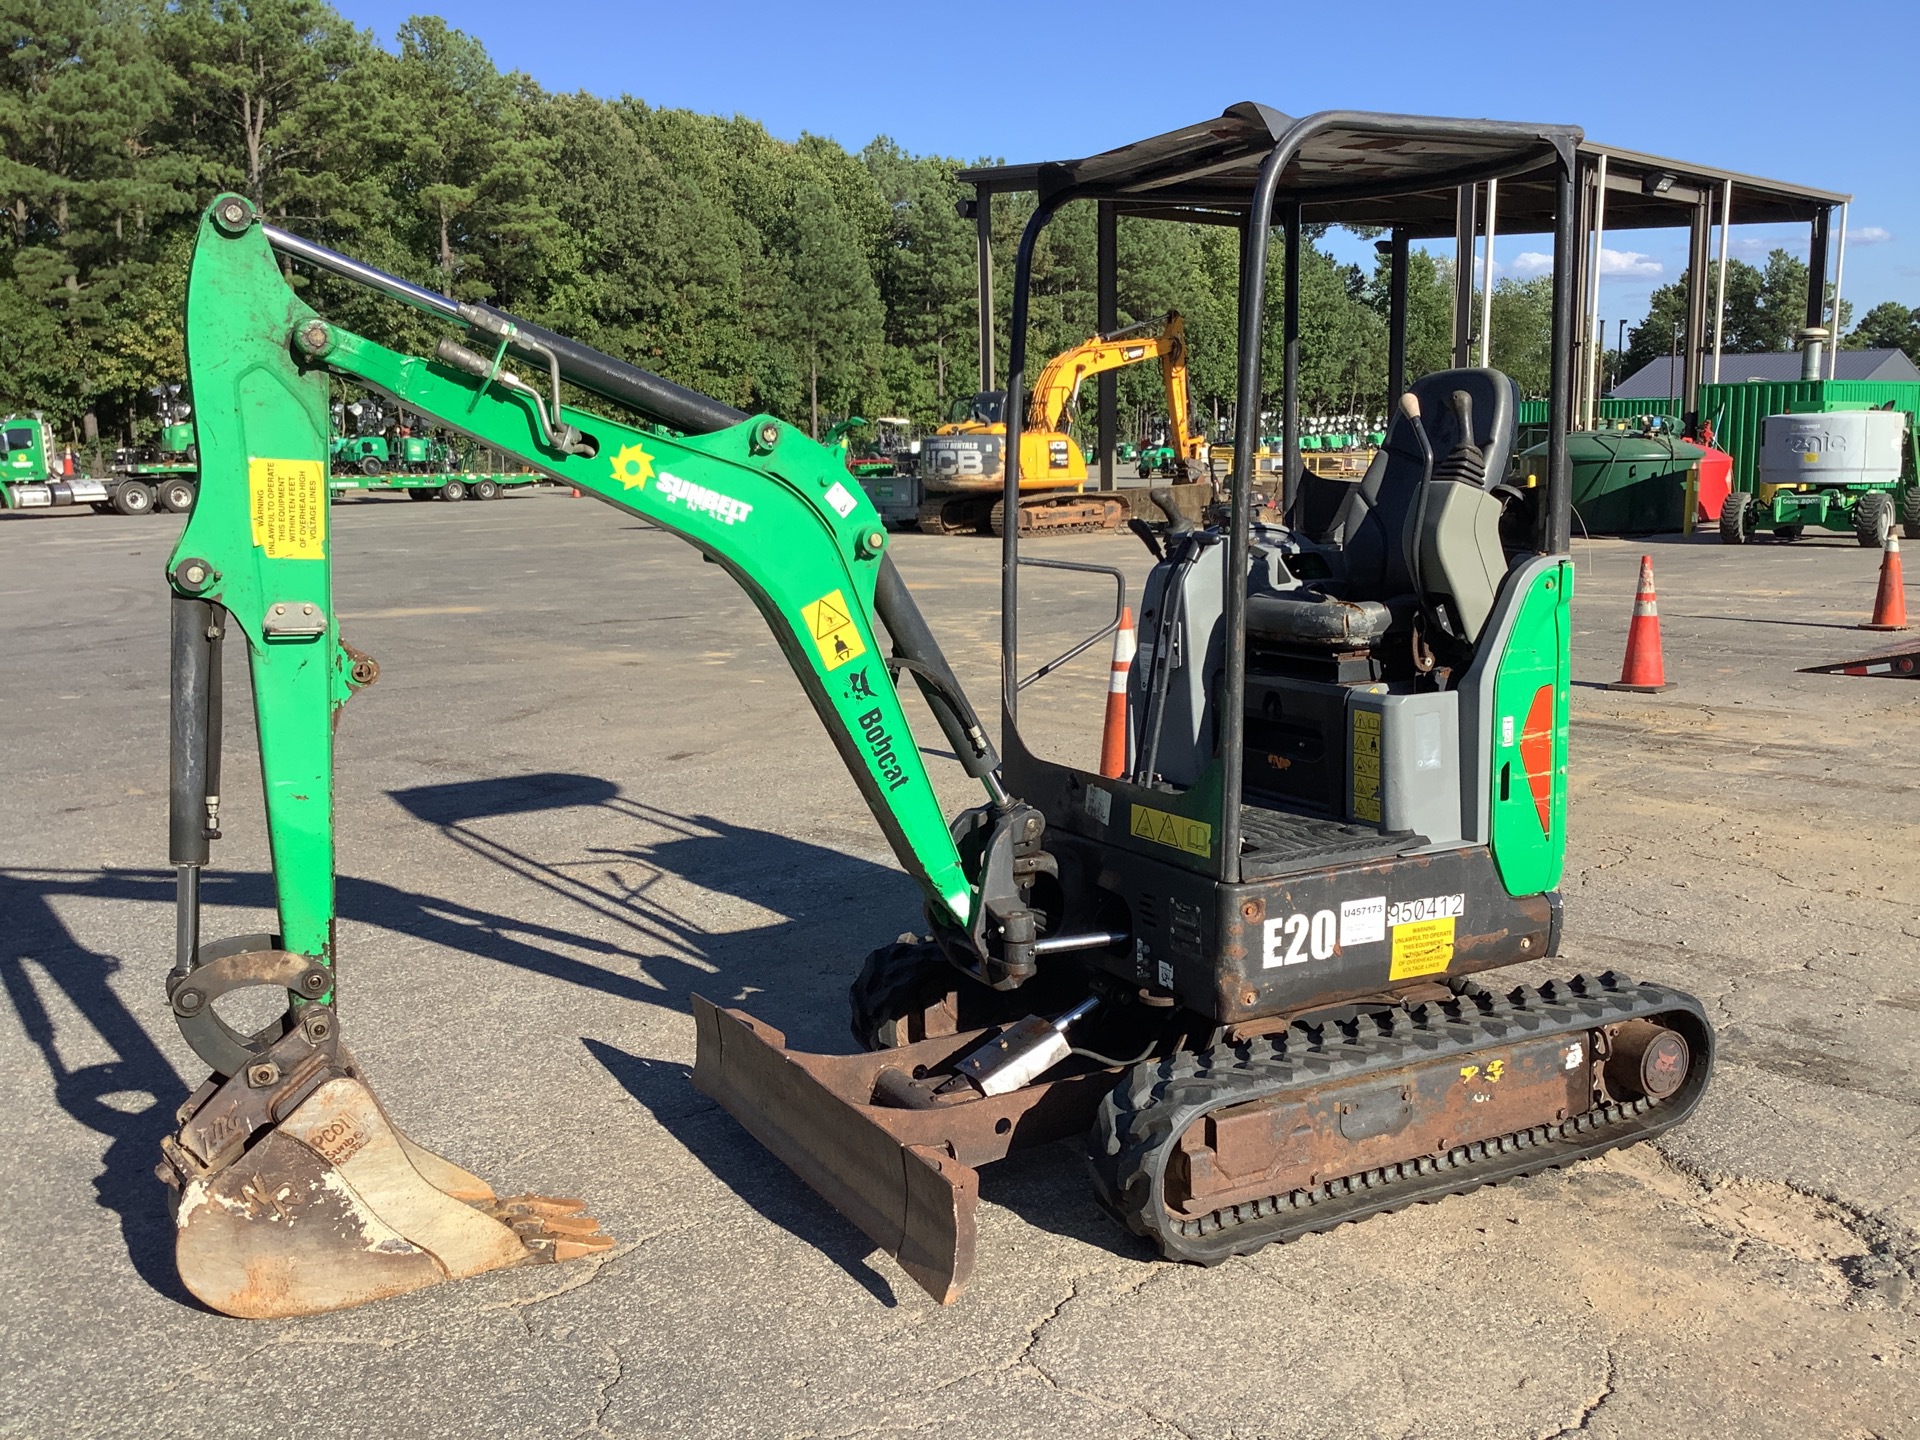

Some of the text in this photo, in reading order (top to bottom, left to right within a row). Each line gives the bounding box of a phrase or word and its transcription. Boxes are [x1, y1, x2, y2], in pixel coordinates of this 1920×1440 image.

[950, 442, 979, 450] RENTALS
[925, 450, 984, 475] JCB
[655, 471, 753, 523] SUNBELT
[257, 490, 265, 527] WARNING
[268, 501, 275, 512] TO
[278, 525, 286, 542] THIS
[300, 537, 306, 548] OF
[858, 706, 910, 792] Bobcat
[1343, 904, 1383, 917] U457173
[1388, 894, 1464, 923] 950412
[1412, 925, 1436, 934] WARNING
[1263, 909, 1337, 969] E20
[1395, 935, 1422, 944] UNLAWFUL
[1430, 930, 1452, 939] OPERATE
[1415, 939, 1444, 949] EQUIPMENT
[1402, 961, 1440, 973] VOLTAGE LINES
[1406, 955, 1434, 966] OVERHEAD
